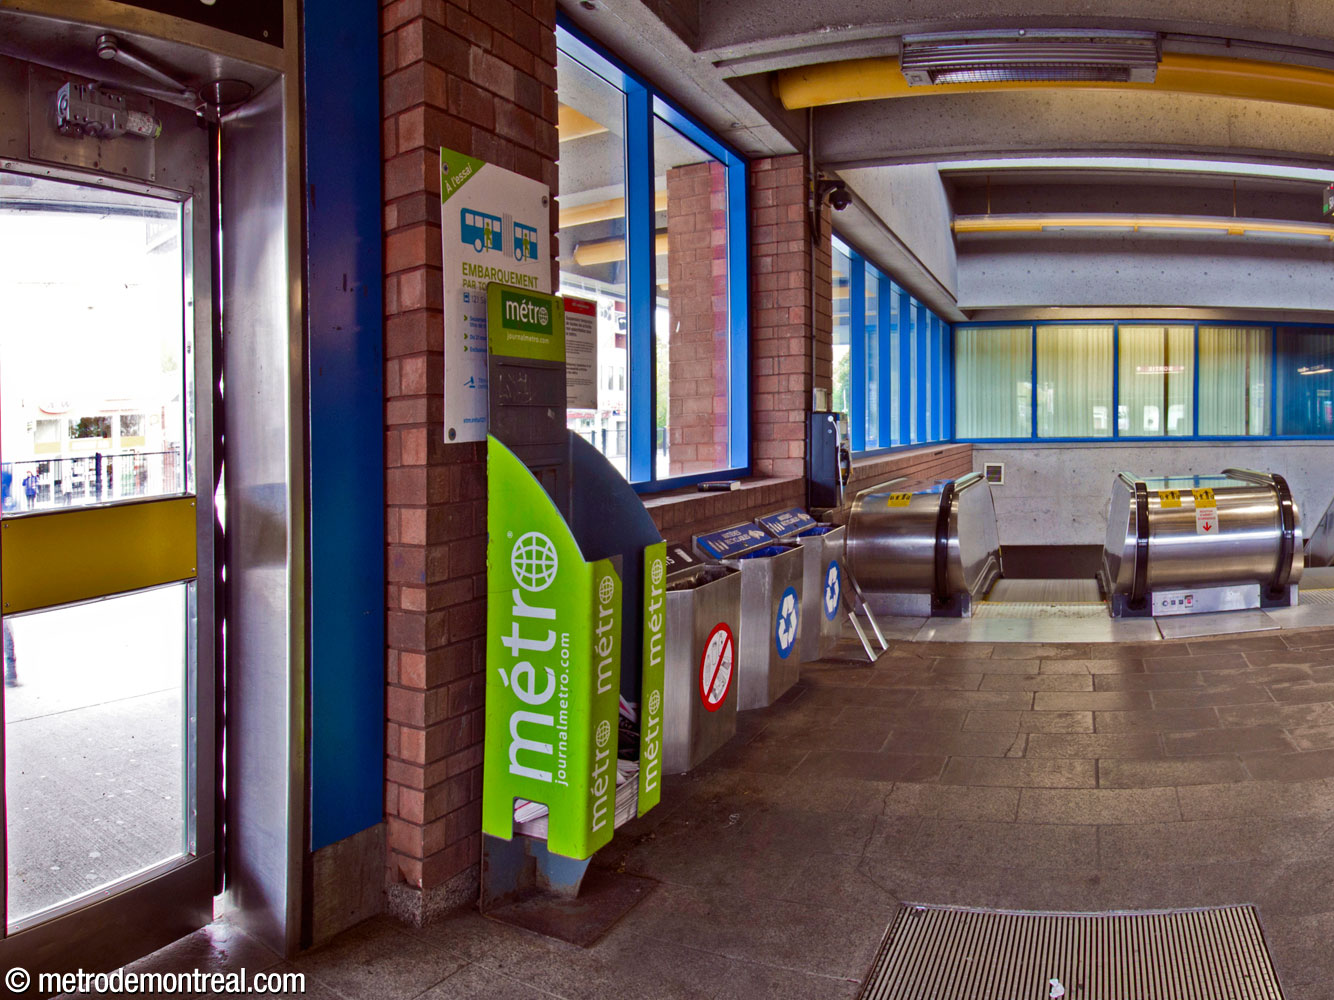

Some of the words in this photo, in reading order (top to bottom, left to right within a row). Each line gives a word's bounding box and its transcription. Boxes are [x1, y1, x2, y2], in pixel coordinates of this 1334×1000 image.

[462, 262, 538, 289] EMBARQUEMENT
[462, 279, 476, 289] PAR
[507, 331, 549, 344] journalmetro.com
[498, 531, 558, 783] métro
[595, 575, 615, 695] métro
[648, 558, 663, 667] métro
[555, 632, 570, 787] journalmetro.com
[644, 689, 661, 793] métro
[591, 719, 611, 833] métro
